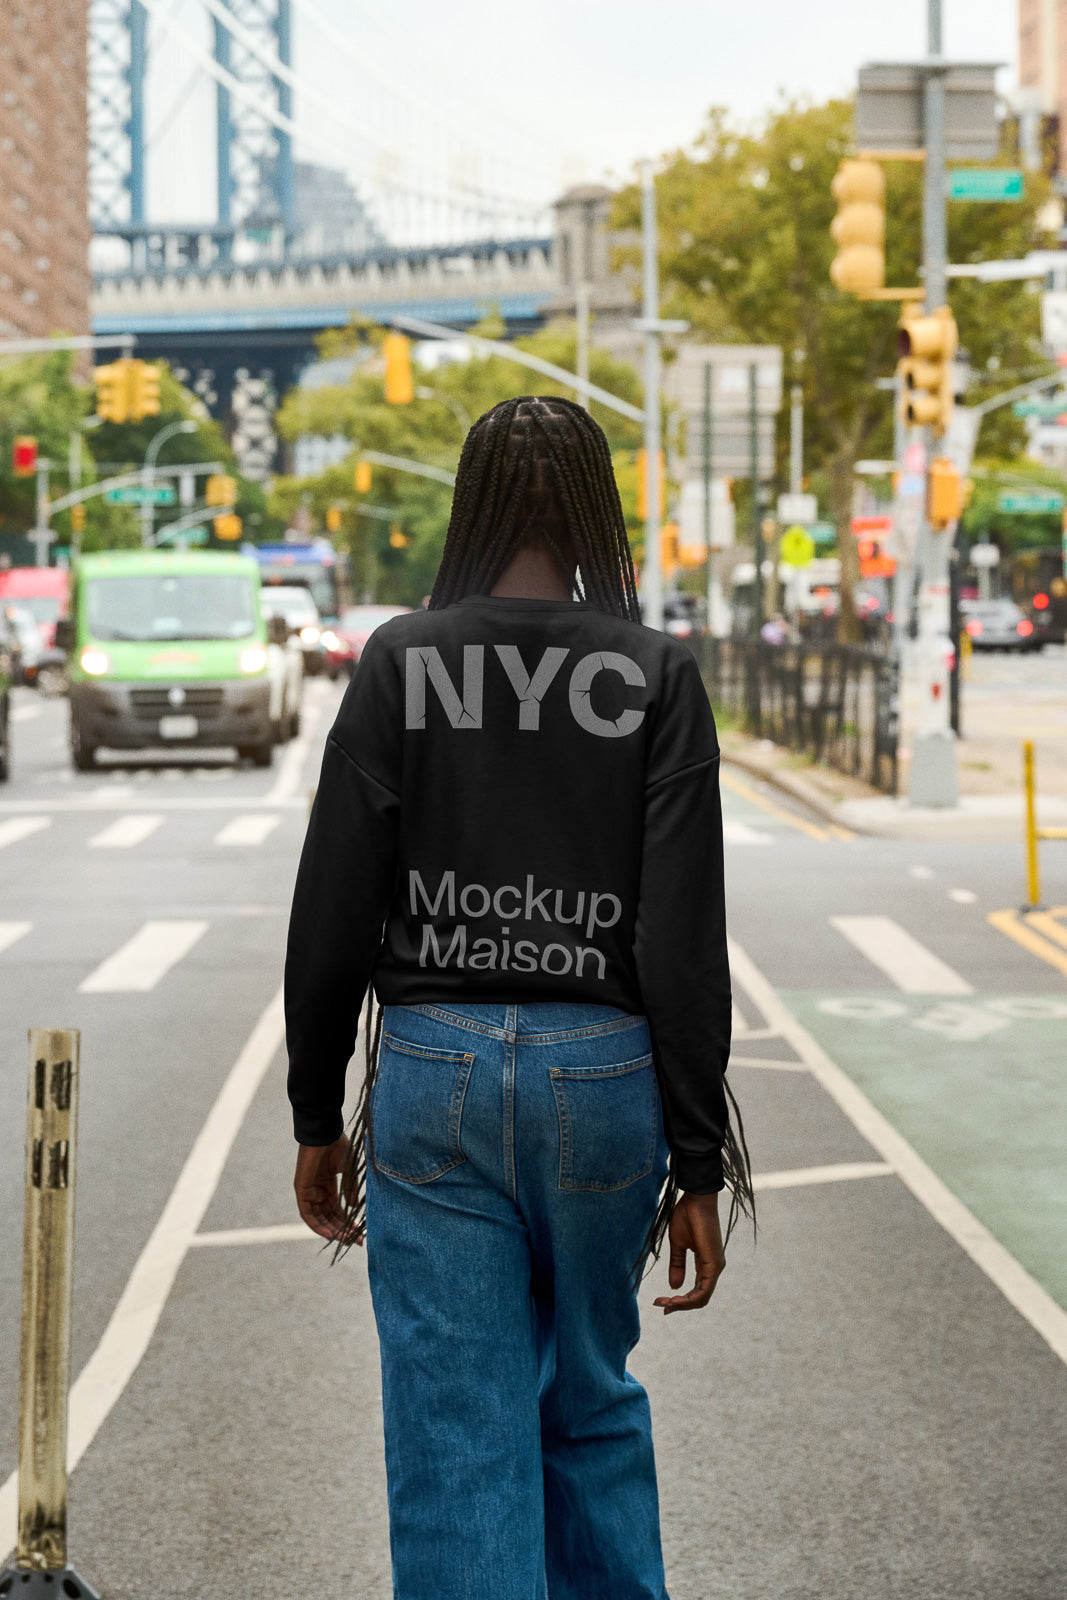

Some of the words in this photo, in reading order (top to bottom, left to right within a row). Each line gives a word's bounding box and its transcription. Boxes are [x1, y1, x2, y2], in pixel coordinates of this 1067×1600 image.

[405, 645, 647, 738] NYC
[408, 870, 622, 939] Mockup
[419, 924, 607, 980] Maison
